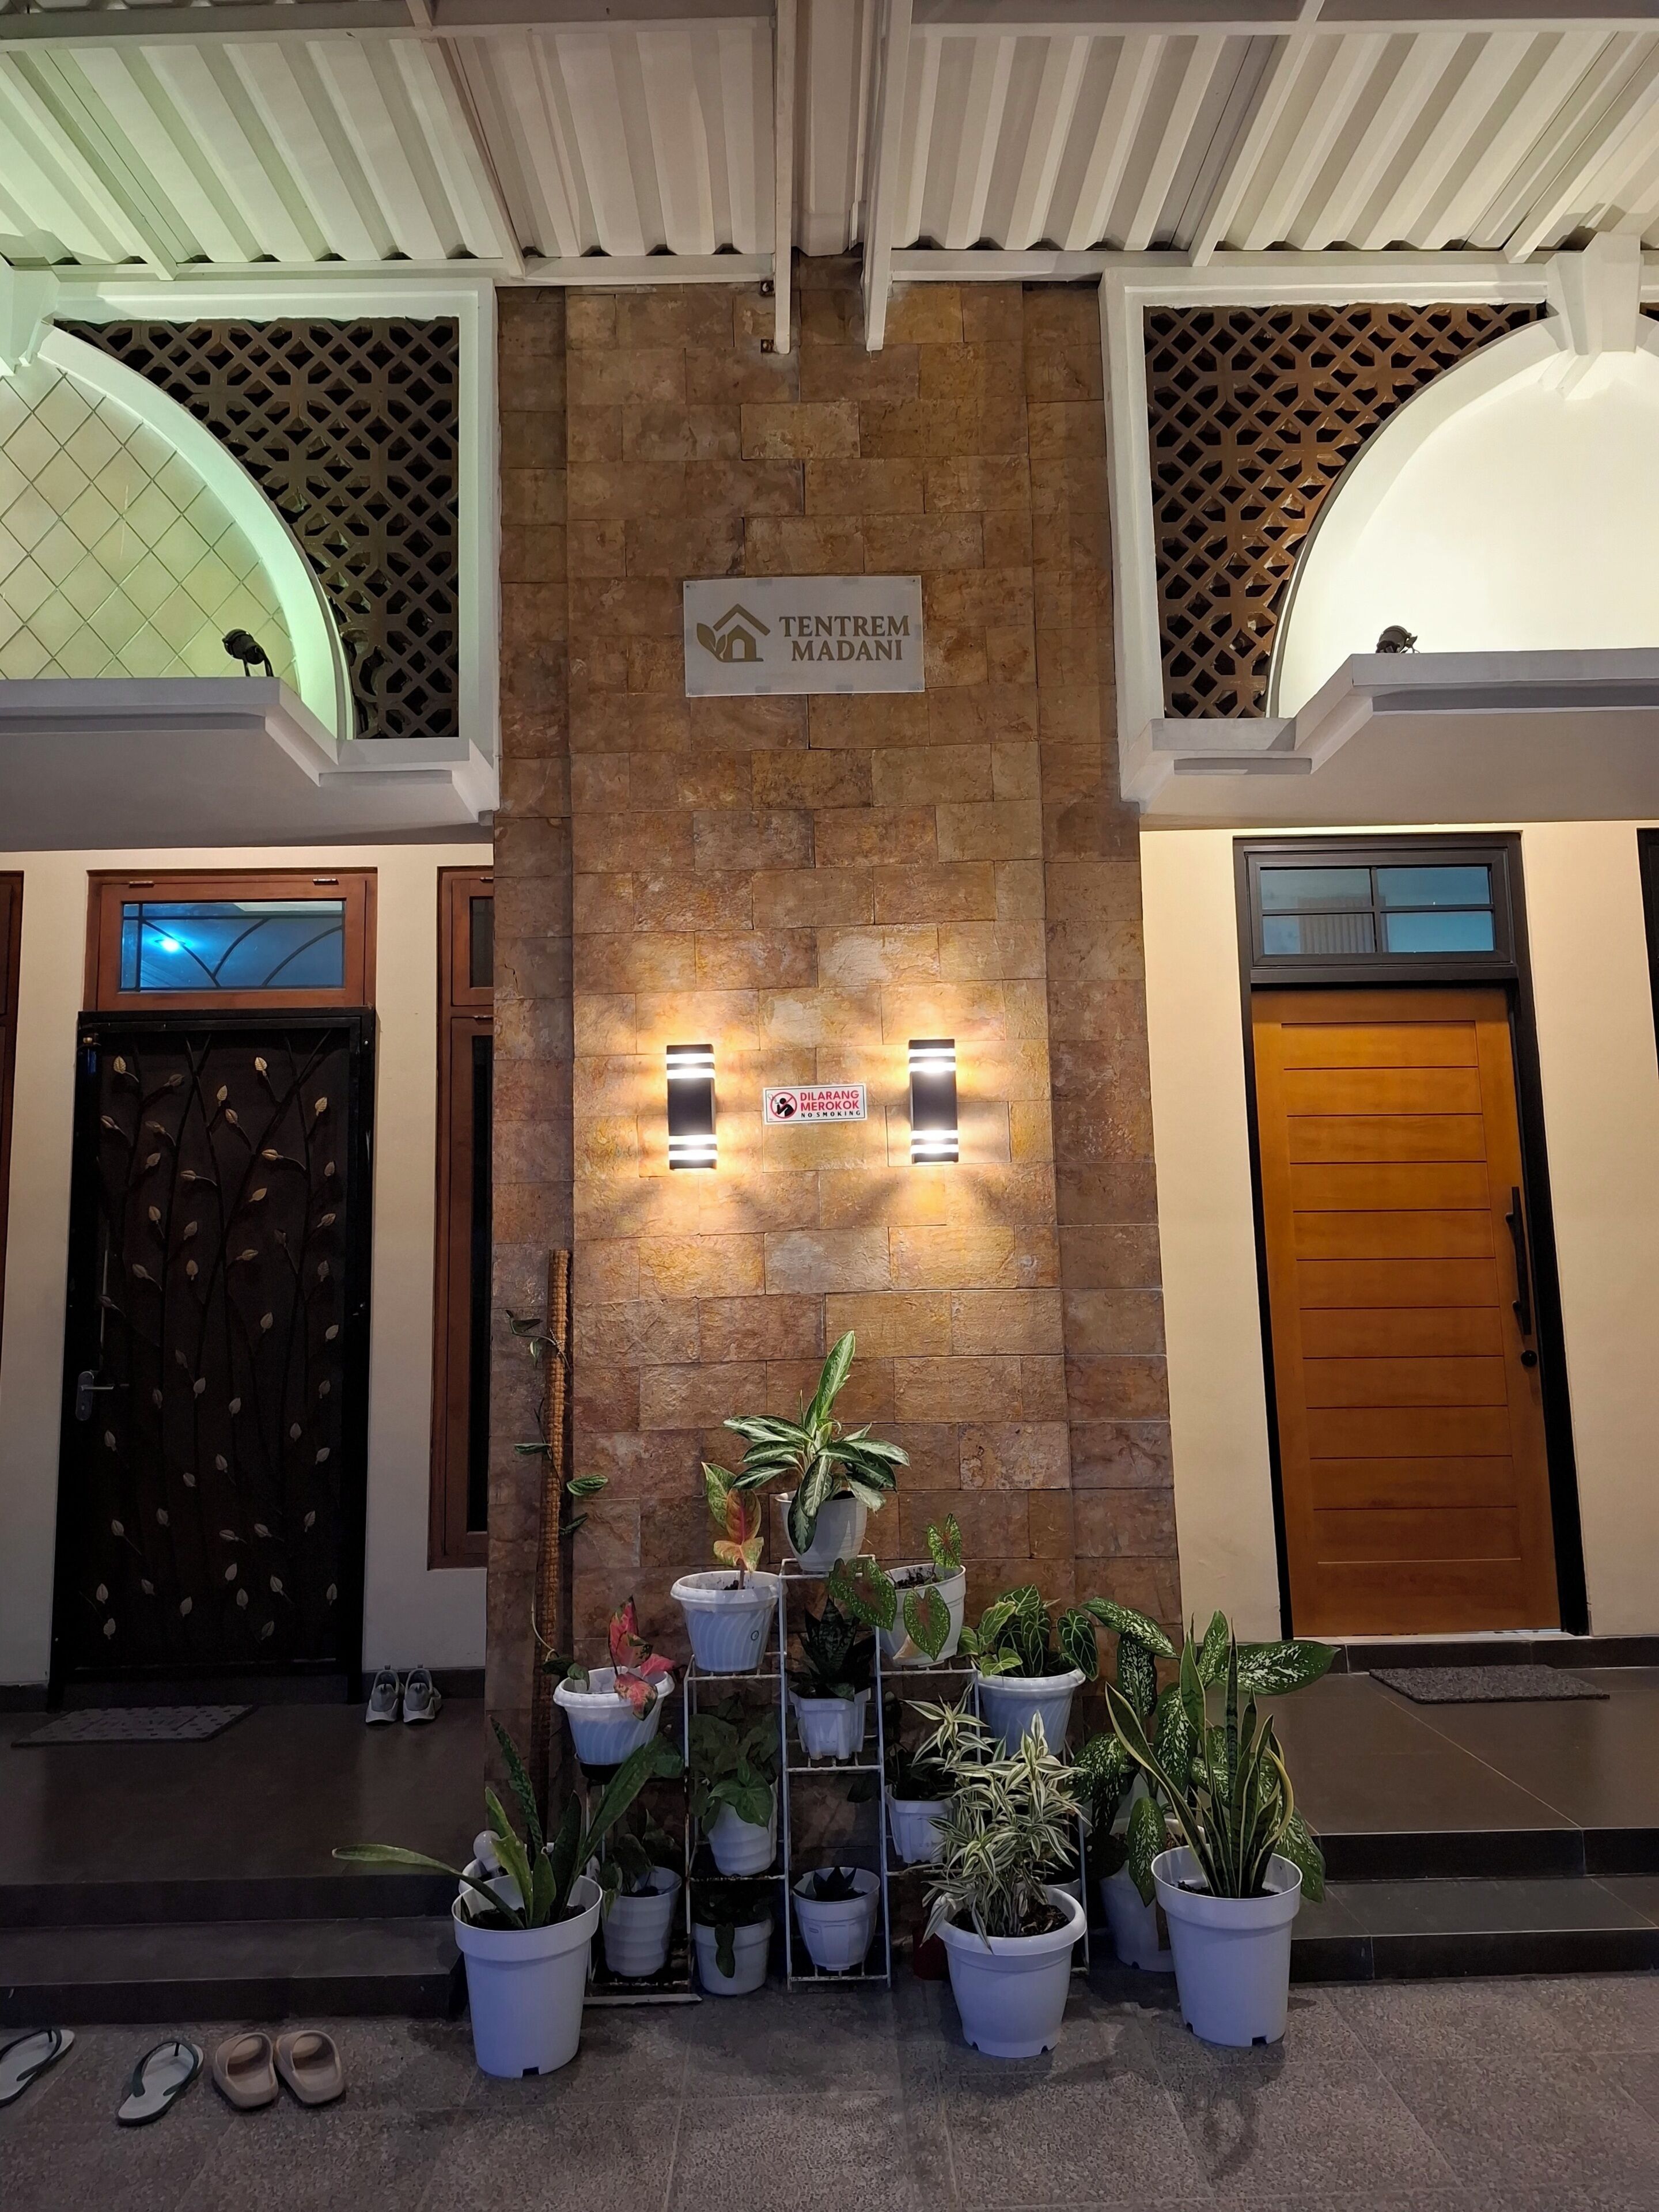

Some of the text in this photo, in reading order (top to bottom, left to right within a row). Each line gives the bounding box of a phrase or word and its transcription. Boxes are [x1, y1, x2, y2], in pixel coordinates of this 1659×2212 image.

[779, 615, 910, 637] TENTREM
[791, 639, 903, 661] MADANI
[800, 1090, 859, 1101] DILARANG
[801, 1100, 859, 1112] MEROKOK
